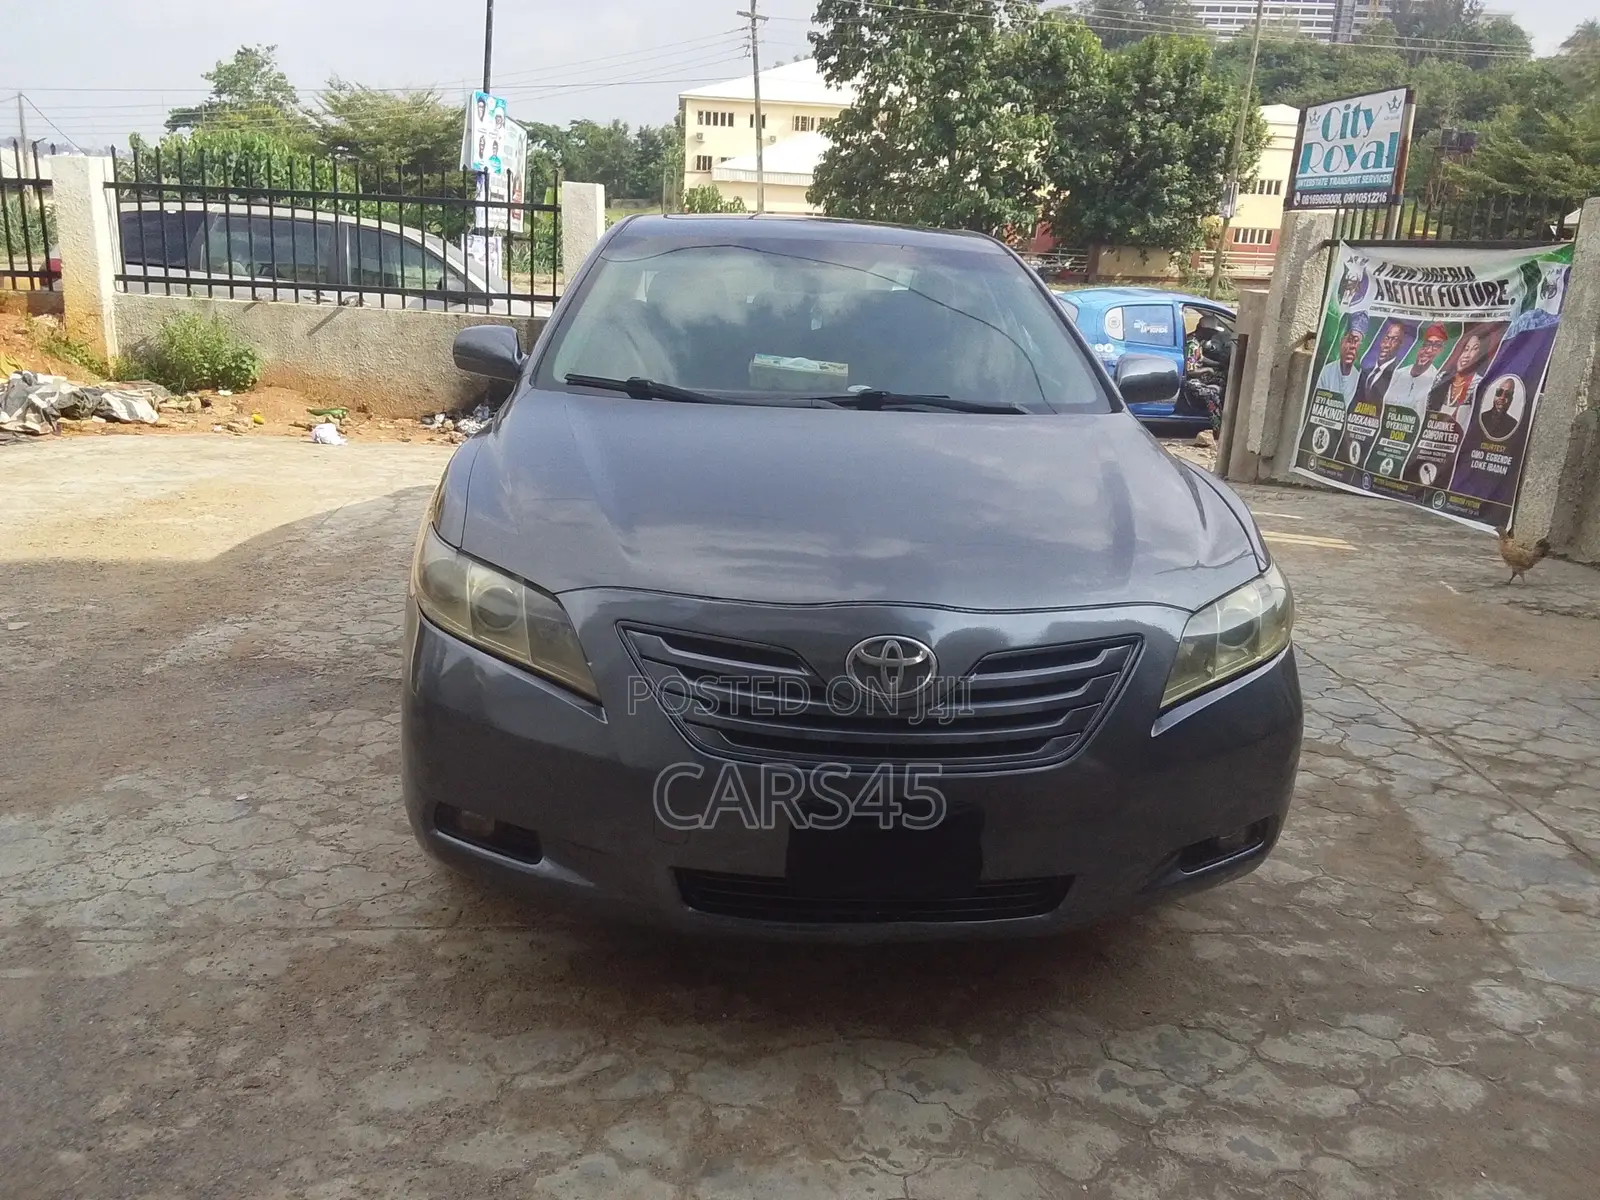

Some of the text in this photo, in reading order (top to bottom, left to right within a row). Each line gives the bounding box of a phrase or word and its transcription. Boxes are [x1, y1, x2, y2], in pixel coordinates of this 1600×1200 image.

[1321, 102, 1382, 142] City
[1299, 132, 1399, 174] Royal
[1329, 176, 1360, 185] TRANSPORT
[1373, 262, 1476, 283] A NEW NIGERIA
[1374, 279, 1516, 307] A BETTER FUTURE.
[1312, 404, 1345, 422] MAKINDE
[1390, 430, 1406, 441] DON
